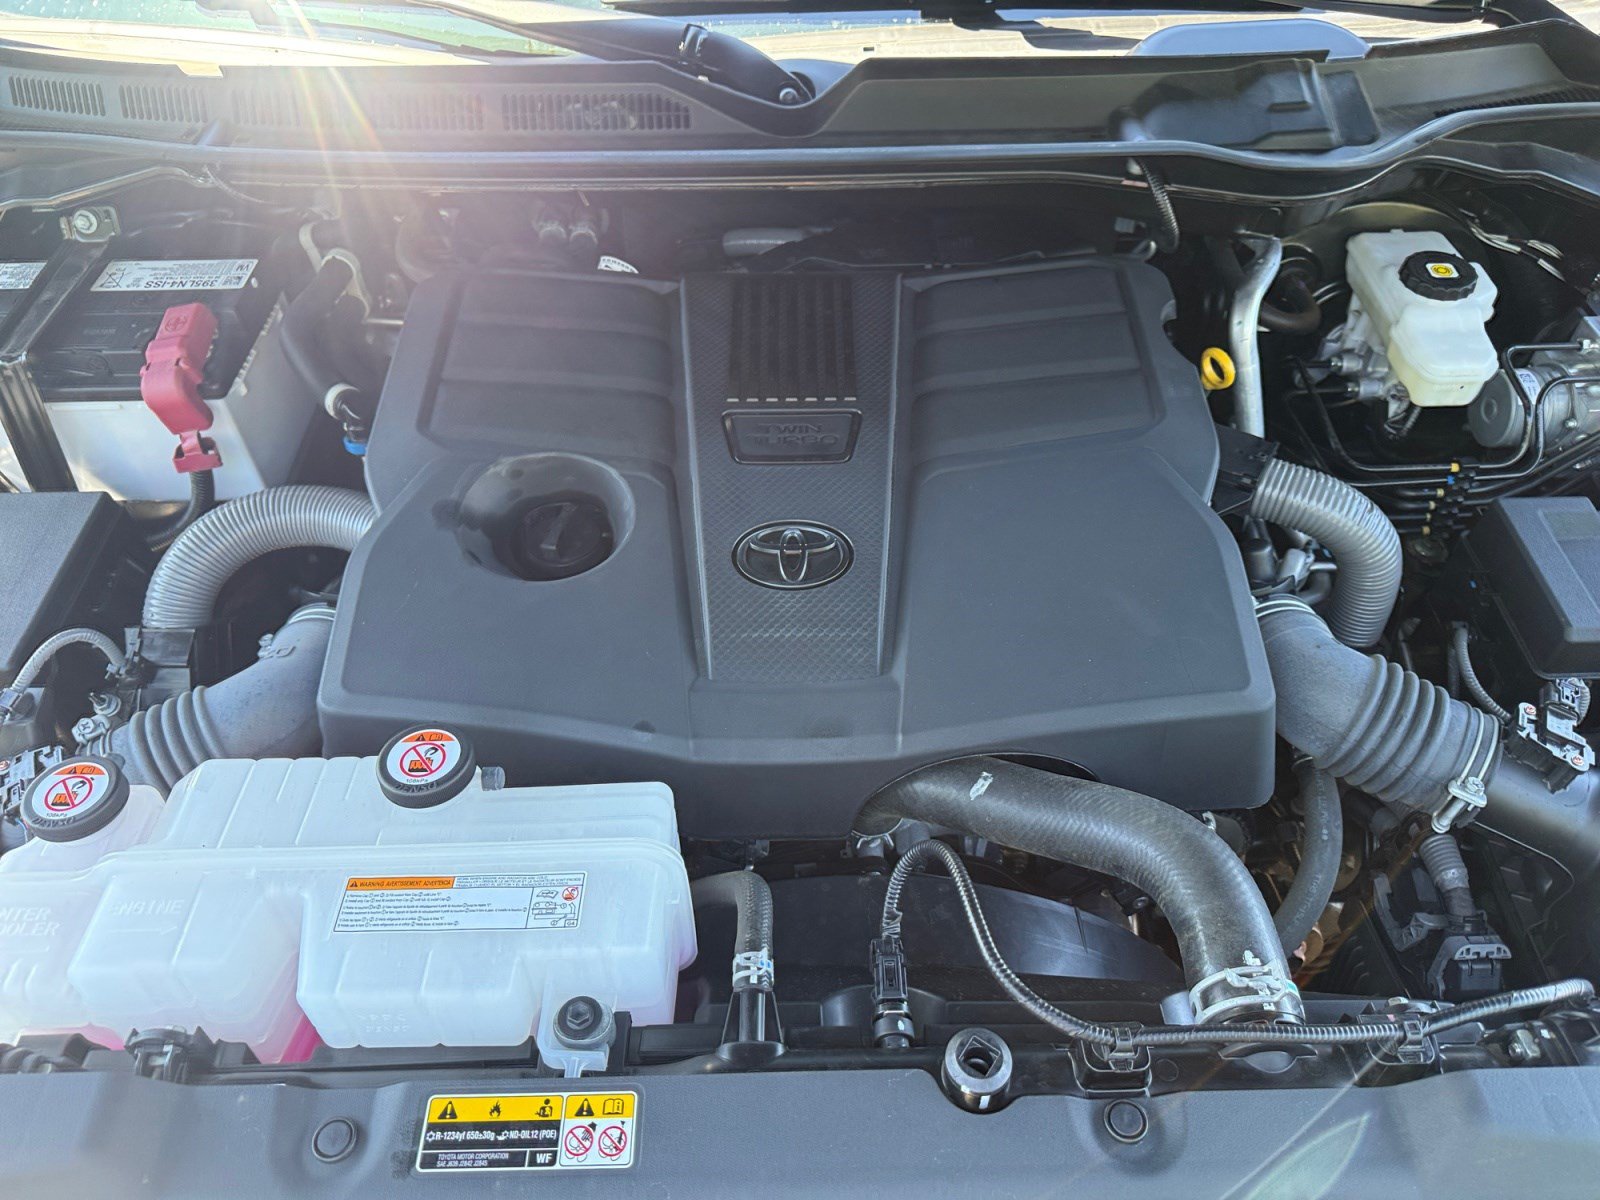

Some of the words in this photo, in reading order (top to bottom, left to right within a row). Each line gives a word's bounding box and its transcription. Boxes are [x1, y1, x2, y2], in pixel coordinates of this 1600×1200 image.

[235, 263, 250, 272] VM
[144, 280, 218, 289] 395LN4-ISS
[757, 423, 824, 434] TWIN
[746, 433, 840, 446] TURBO
[395, 782, 438, 793] DENSO
[112, 899, 185, 915] ENGINE
[435, 1131, 466, 1141] R-1234yf
[466, 1130, 496, 1141] 650±30g
[539, 1129, 557, 1140] (POE)
[438, 1153, 457, 1161] TOYOTA
[475, 1152, 509, 1160] CORPORATION
[536, 1152, 553, 1164] WF
